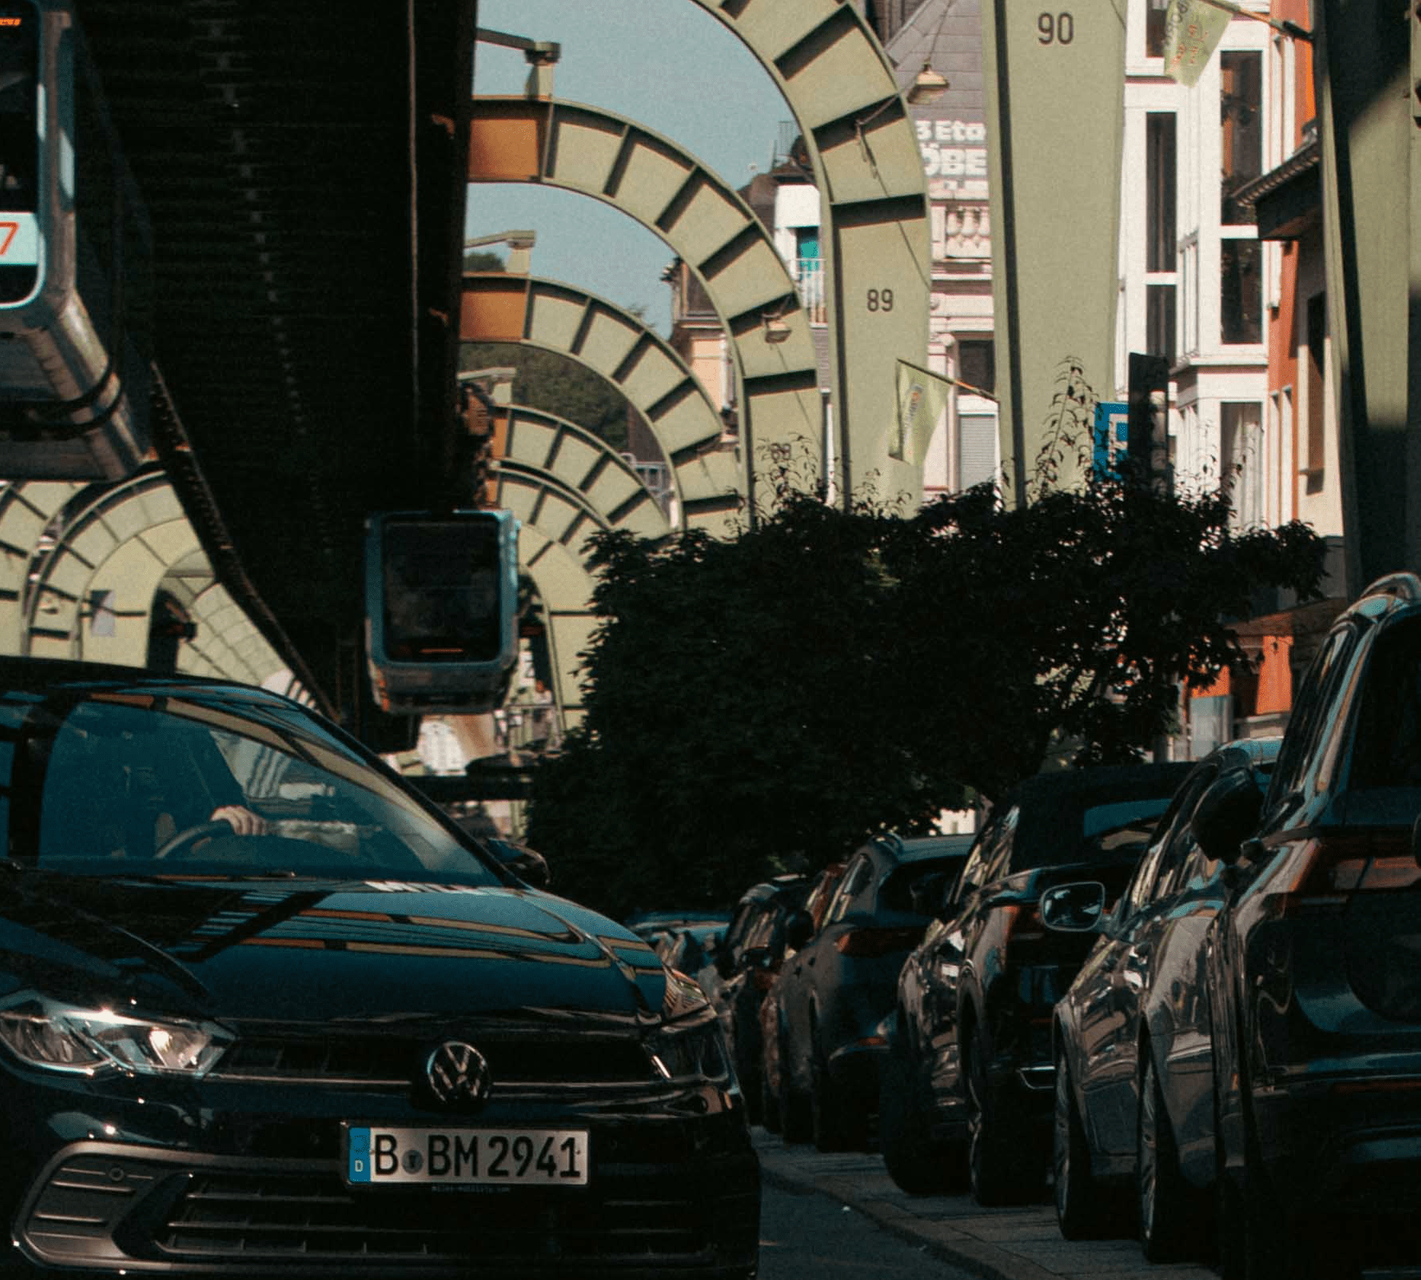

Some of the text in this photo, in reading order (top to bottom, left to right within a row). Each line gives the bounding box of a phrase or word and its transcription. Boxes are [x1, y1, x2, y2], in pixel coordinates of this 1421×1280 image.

[1038, 12, 1074, 45] 90
[867, 288, 893, 312] 89
[354, 1134, 581, 1178] D B BM 2941
